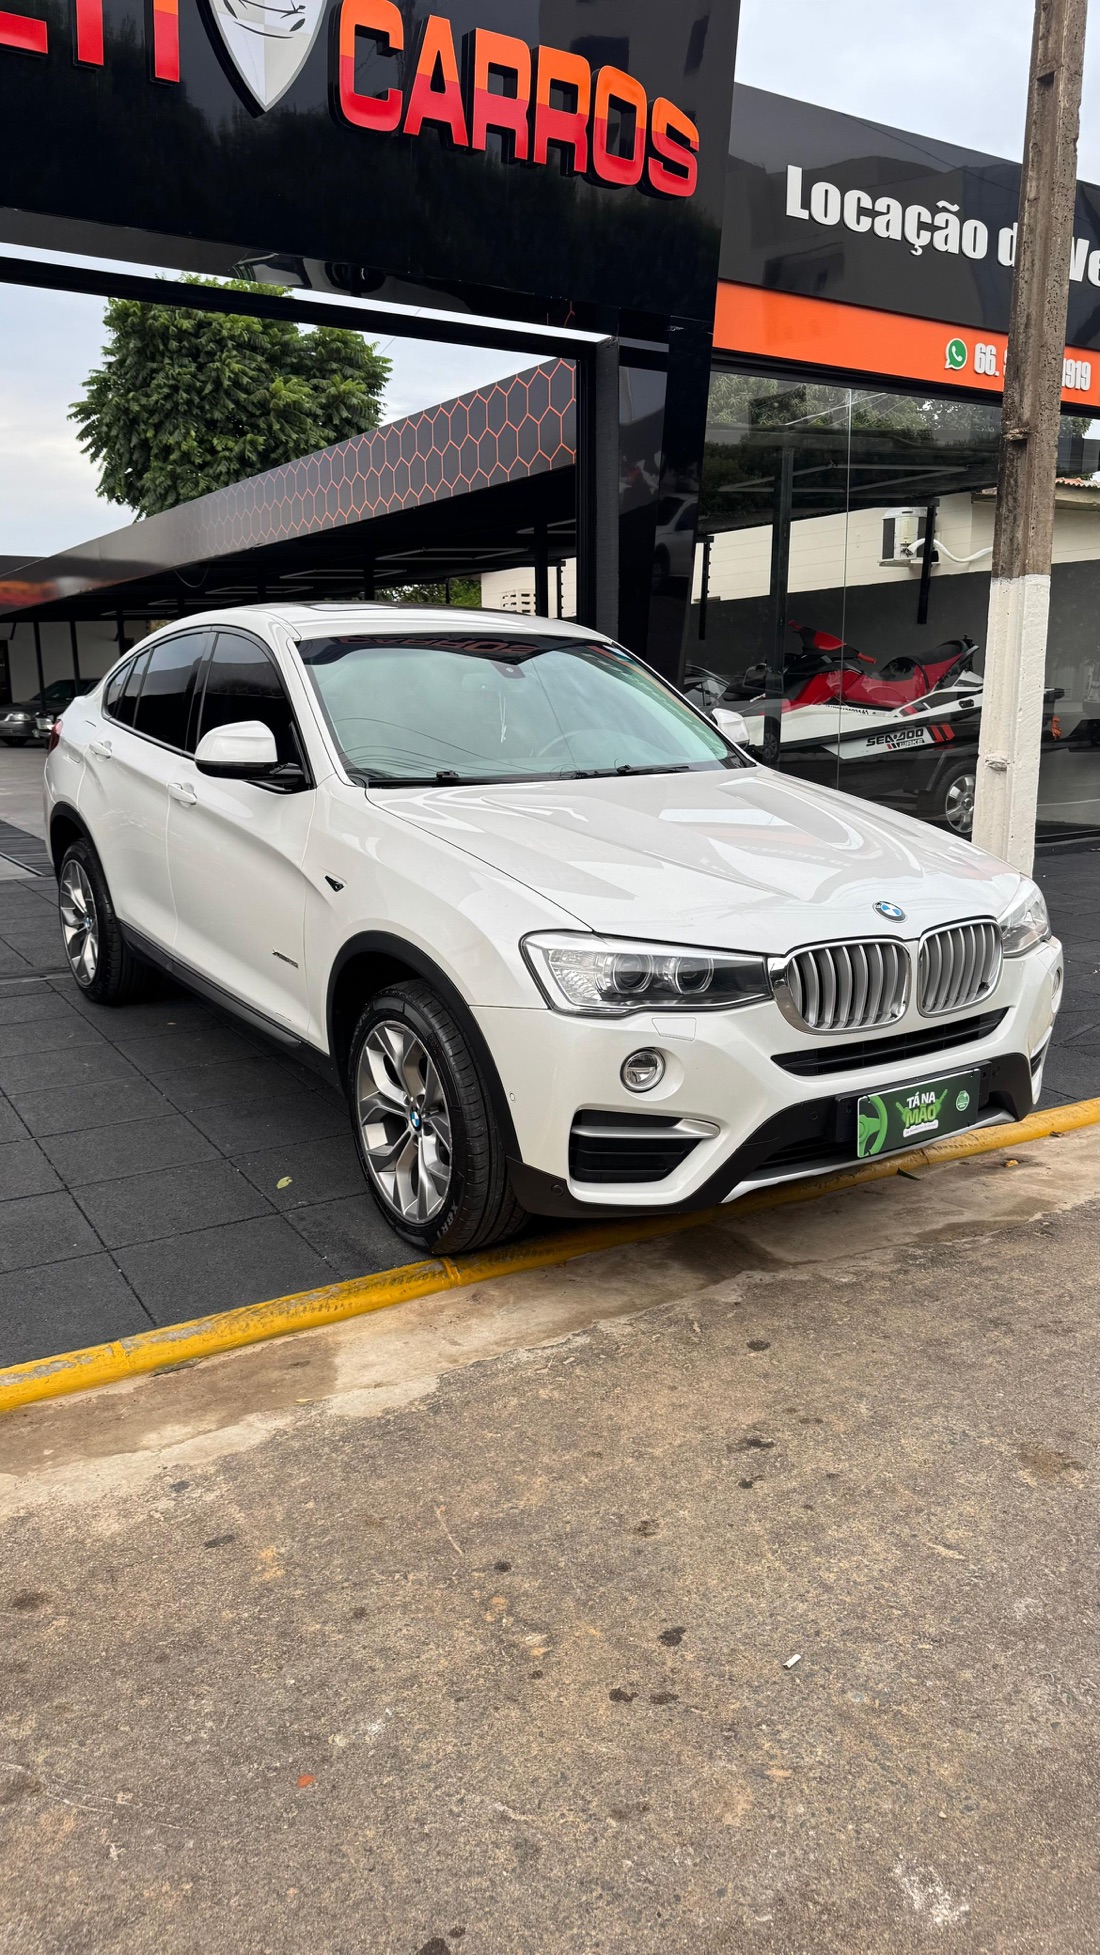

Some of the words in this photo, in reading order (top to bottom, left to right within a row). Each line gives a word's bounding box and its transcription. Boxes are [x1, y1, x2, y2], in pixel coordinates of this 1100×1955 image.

[337, 0, 699, 197] CARROS
[786, 164, 988, 260] Locação
[904, 1103, 937, 1128] MÃO
[906, 1091, 920, 1109] TÁ
[921, 1091, 936, 1104] NA
